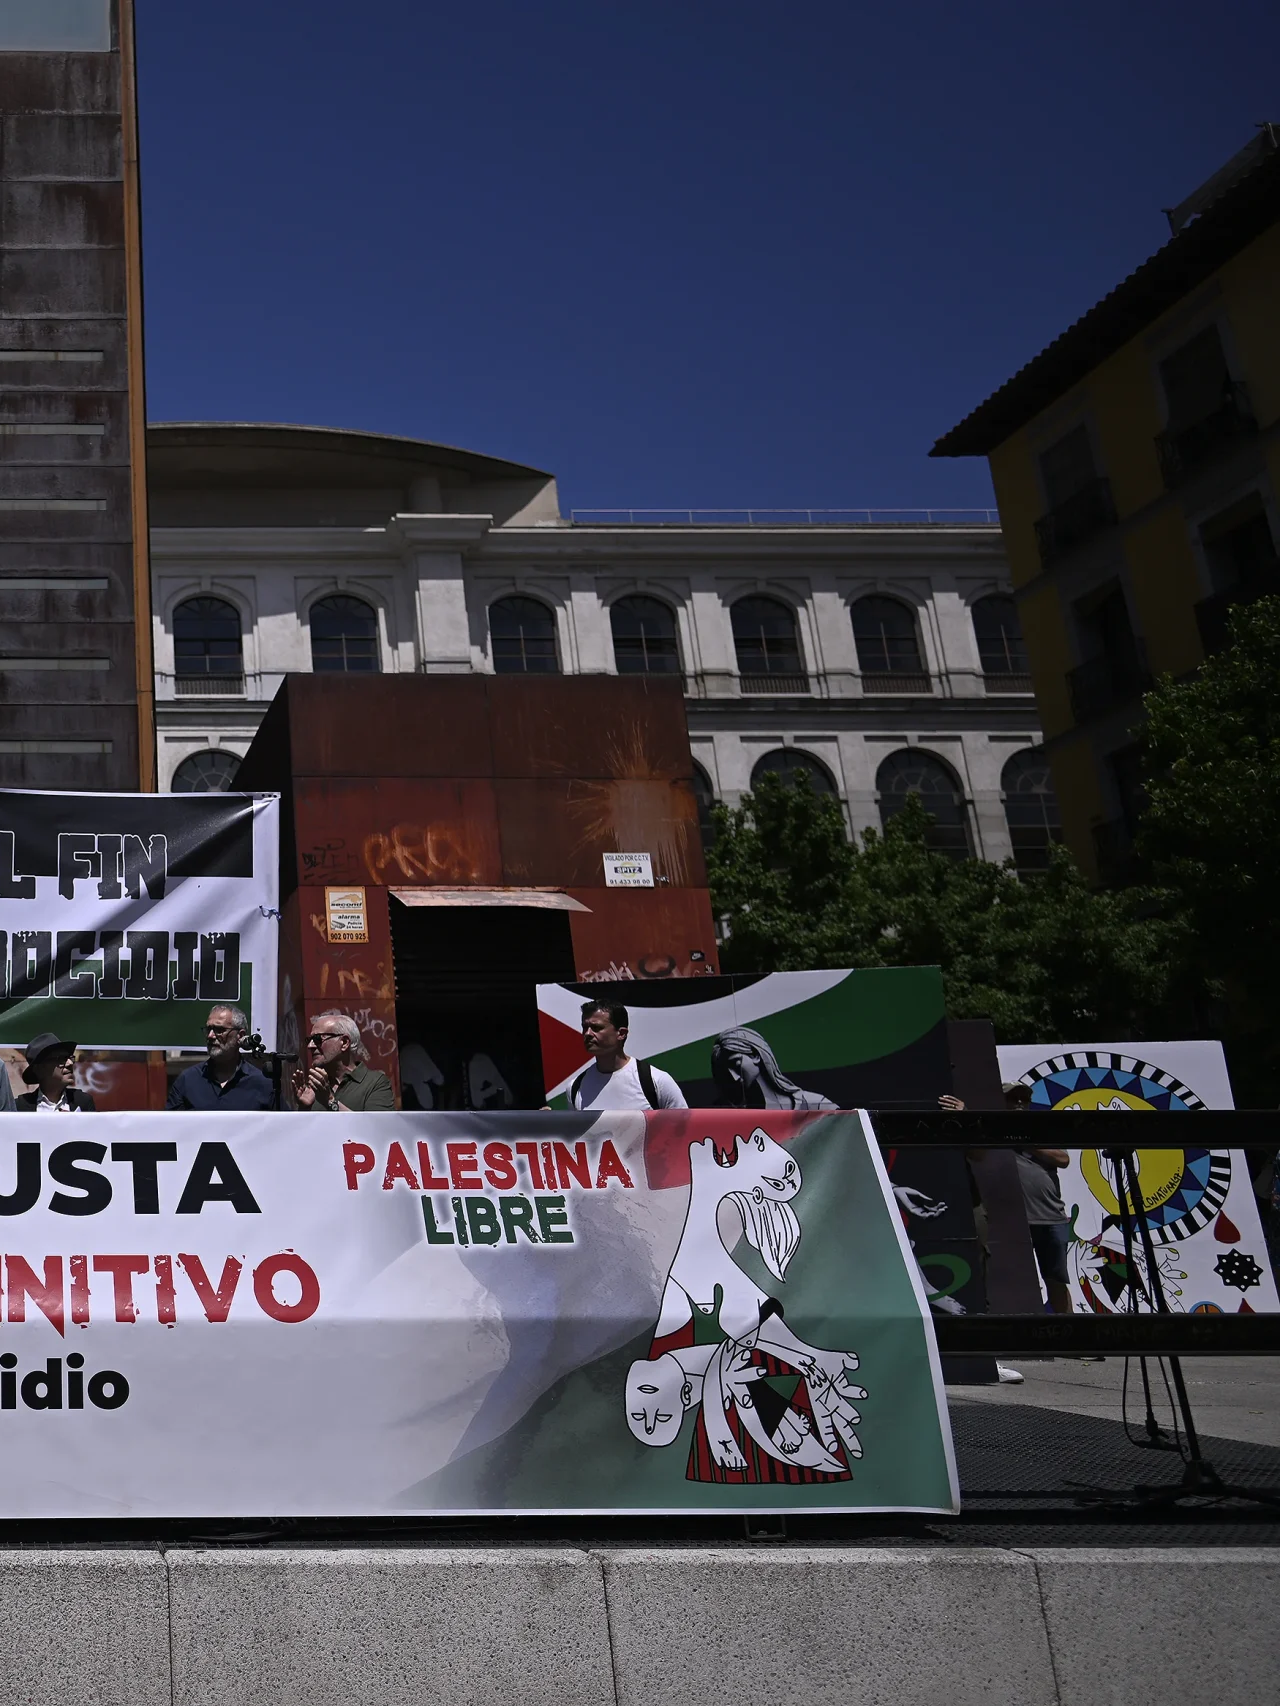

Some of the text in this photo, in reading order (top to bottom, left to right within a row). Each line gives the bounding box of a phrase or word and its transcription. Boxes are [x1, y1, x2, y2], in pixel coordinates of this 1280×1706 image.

[58, 831, 168, 901] FIN
[331, 932, 367, 940] 902 070 925
[342, 1139, 635, 1192] PALESTINA
[421, 1193, 575, 1248] LIBRE
